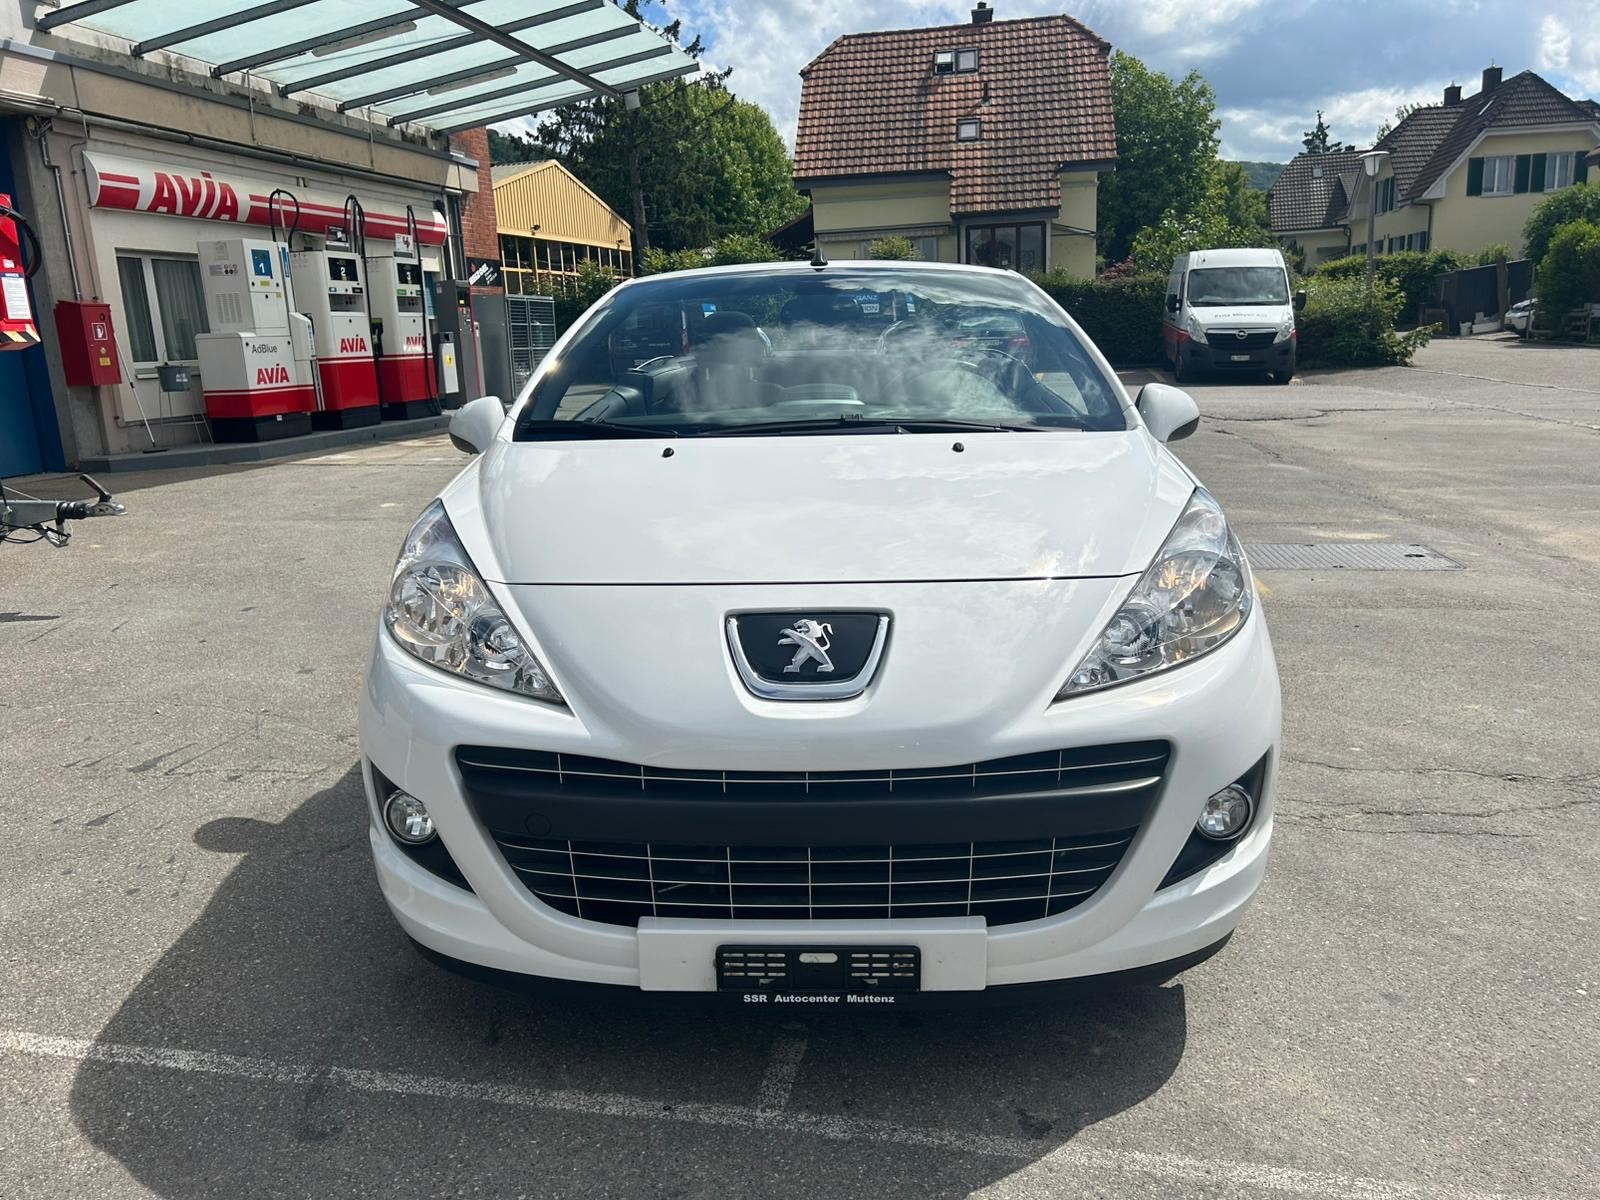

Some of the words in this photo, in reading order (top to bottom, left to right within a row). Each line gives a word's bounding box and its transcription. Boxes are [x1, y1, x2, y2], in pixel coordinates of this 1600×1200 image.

[147, 171, 239, 221] AVIA
[259, 262, 265, 274] 1
[340, 266, 346, 277] 2
[406, 271, 412, 281] 3
[251, 343, 278, 354] AdBlue
[340, 334, 367, 353] AVIA
[256, 363, 290, 385] AVIA
[743, 994, 768, 1003] SSR
[774, 994, 841, 1003] Autocenter
[847, 994, 895, 1003] Muttenz
